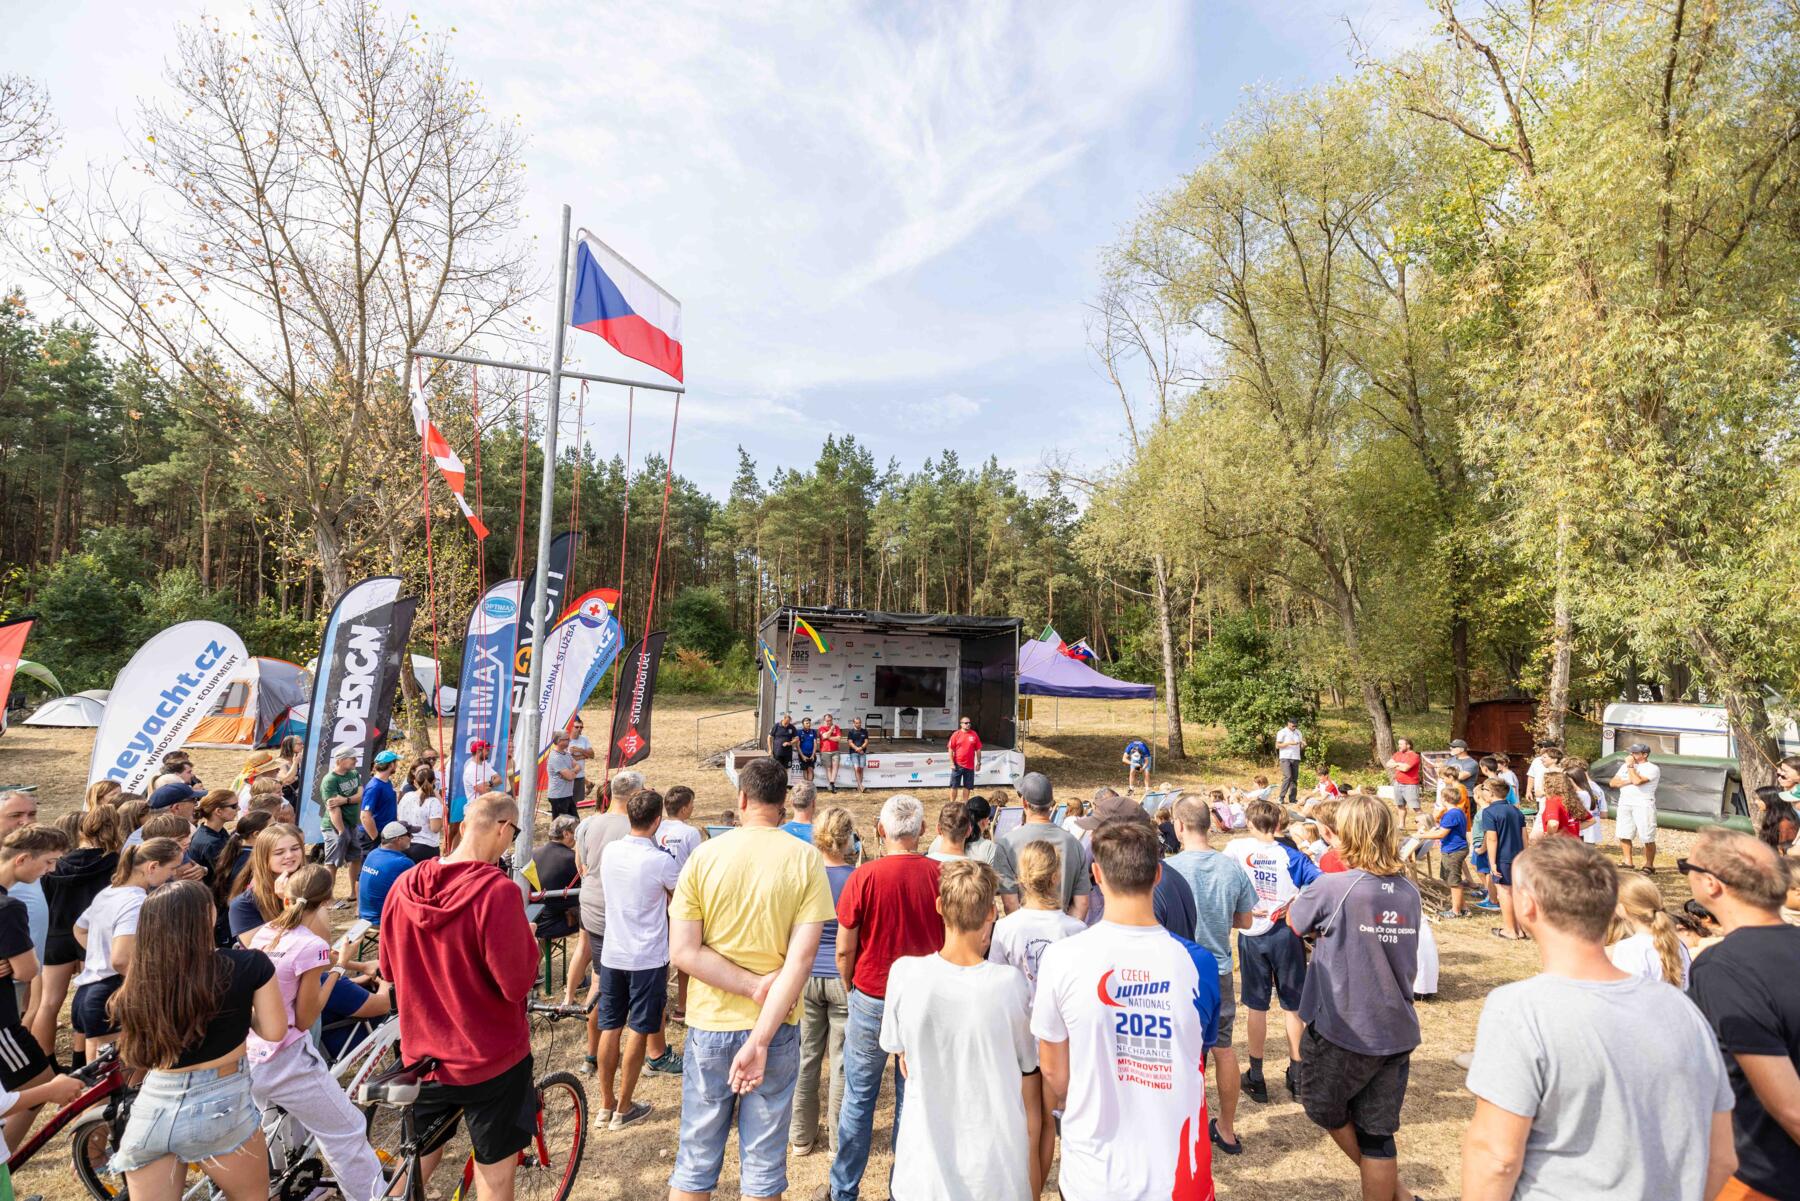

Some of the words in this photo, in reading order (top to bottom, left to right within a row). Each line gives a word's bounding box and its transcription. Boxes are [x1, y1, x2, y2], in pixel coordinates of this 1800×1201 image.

[557, 623, 577, 661] SLUŽBA
[792, 650, 809, 659] 2025
[464, 644, 499, 755] PTIMAX
[107, 640, 227, 784] neyacht.cz
[145, 705, 196, 767] WINDSURFING
[197, 654, 239, 701] EQUIPMENT
[1254, 870, 1278, 883] 2025
[1382, 911, 1398, 924] 22
[1121, 969, 1150, 982] CZECH
[1115, 981, 1170, 999] JUNIOR
[1128, 998, 1171, 1010] NATIONALS
[1116, 1012, 1172, 1040] 2025
[1116, 1044, 1171, 1058] NECHRANICE
[1126, 1075, 1172, 1090] JACHTINGU
